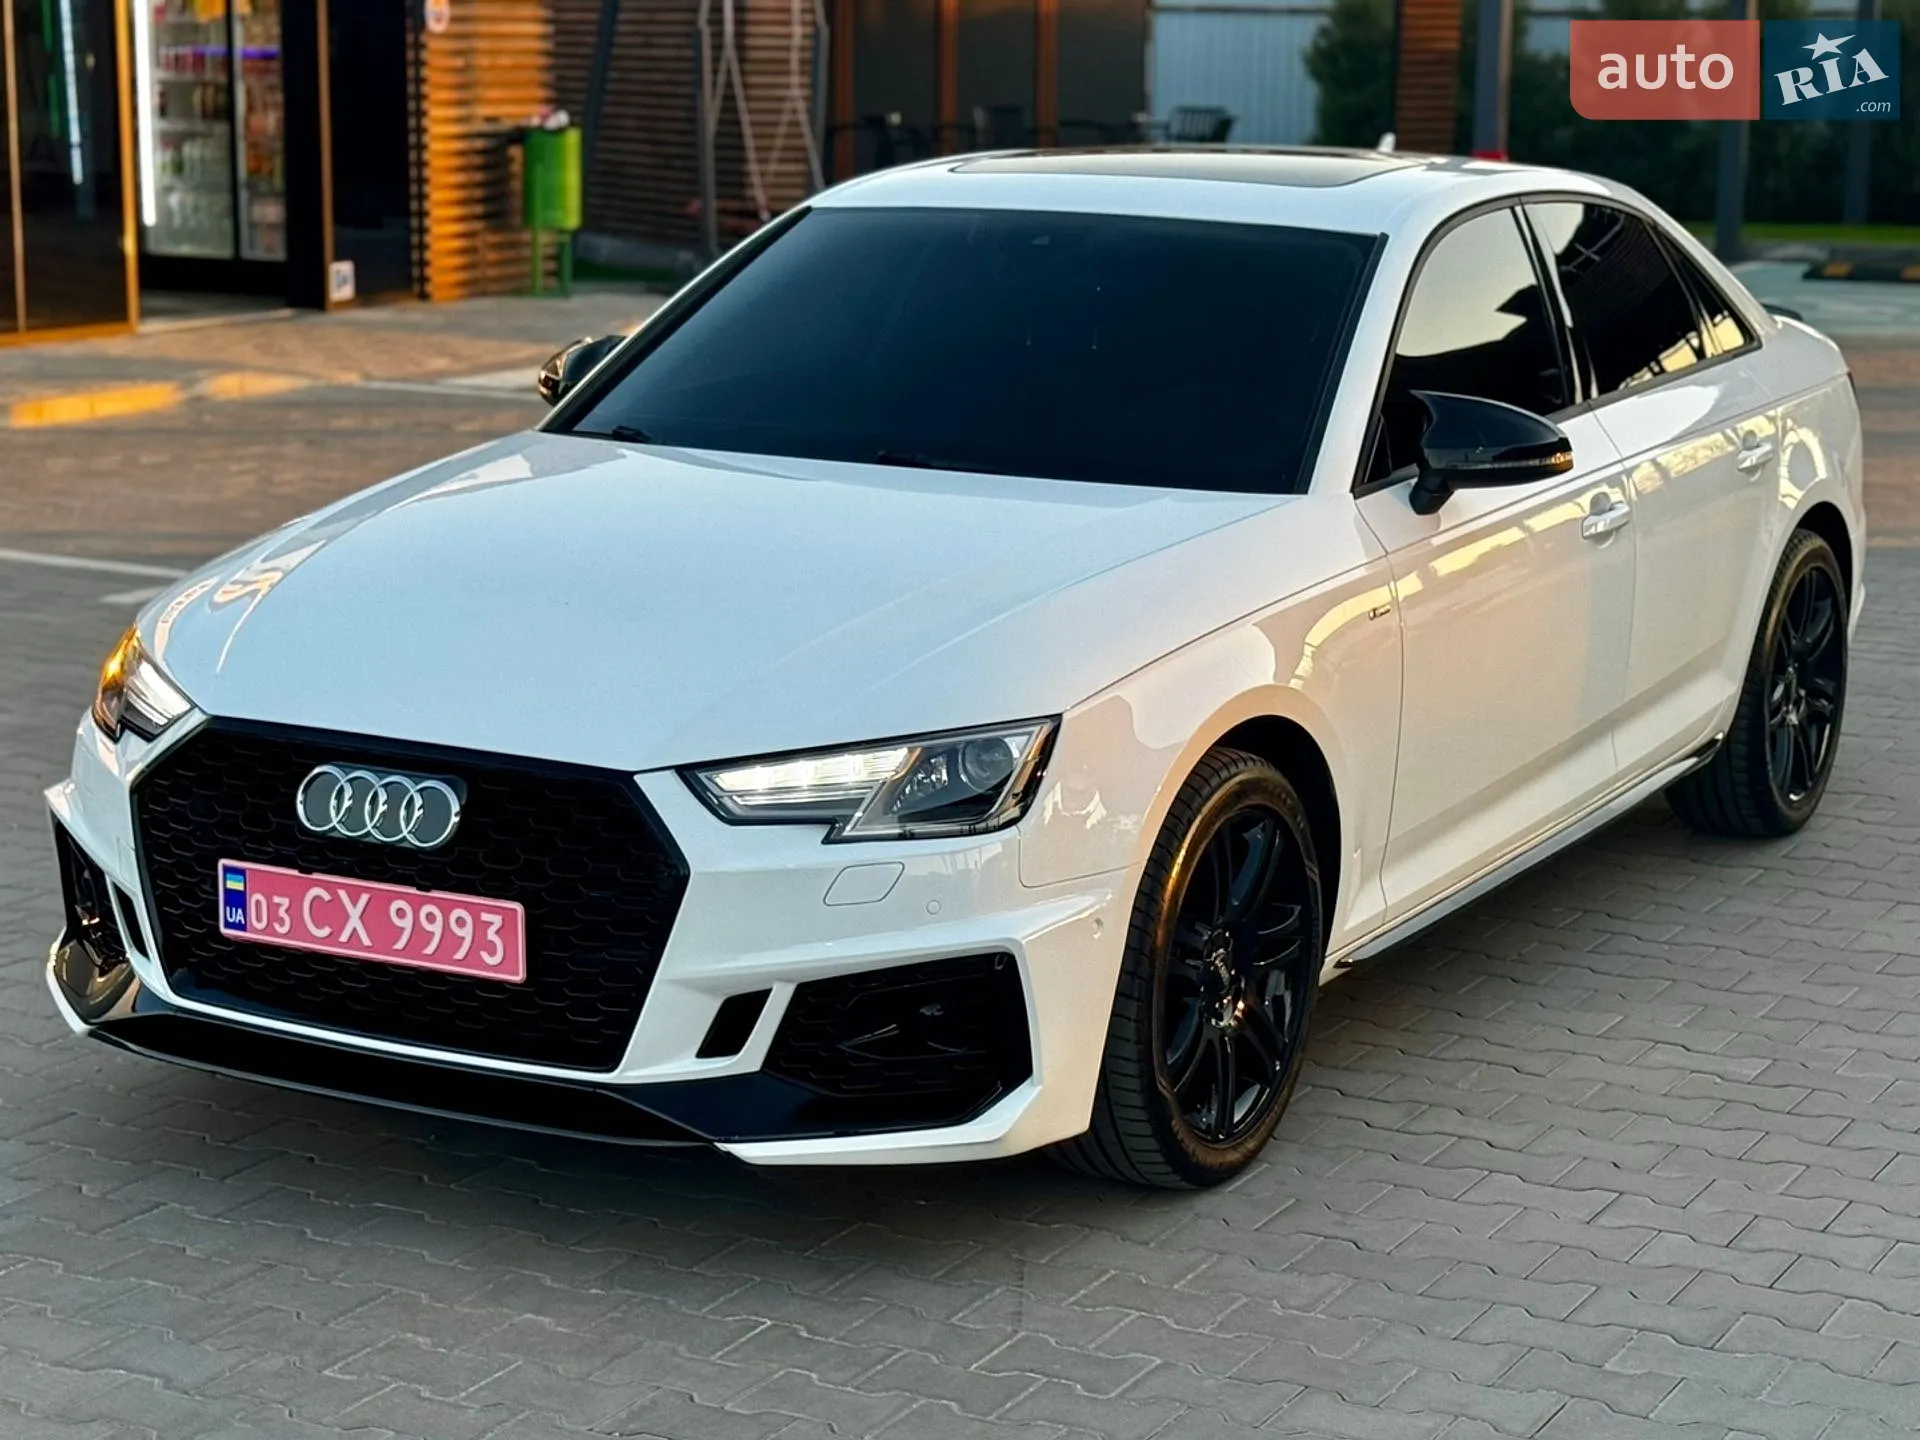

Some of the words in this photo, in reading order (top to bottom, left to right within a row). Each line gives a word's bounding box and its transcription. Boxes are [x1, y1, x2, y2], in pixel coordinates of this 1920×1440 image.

[225, 906, 245, 925] UA
[251, 892, 291, 935] 03
[302, 886, 373, 946] CX
[389, 899, 505, 966] 9993
